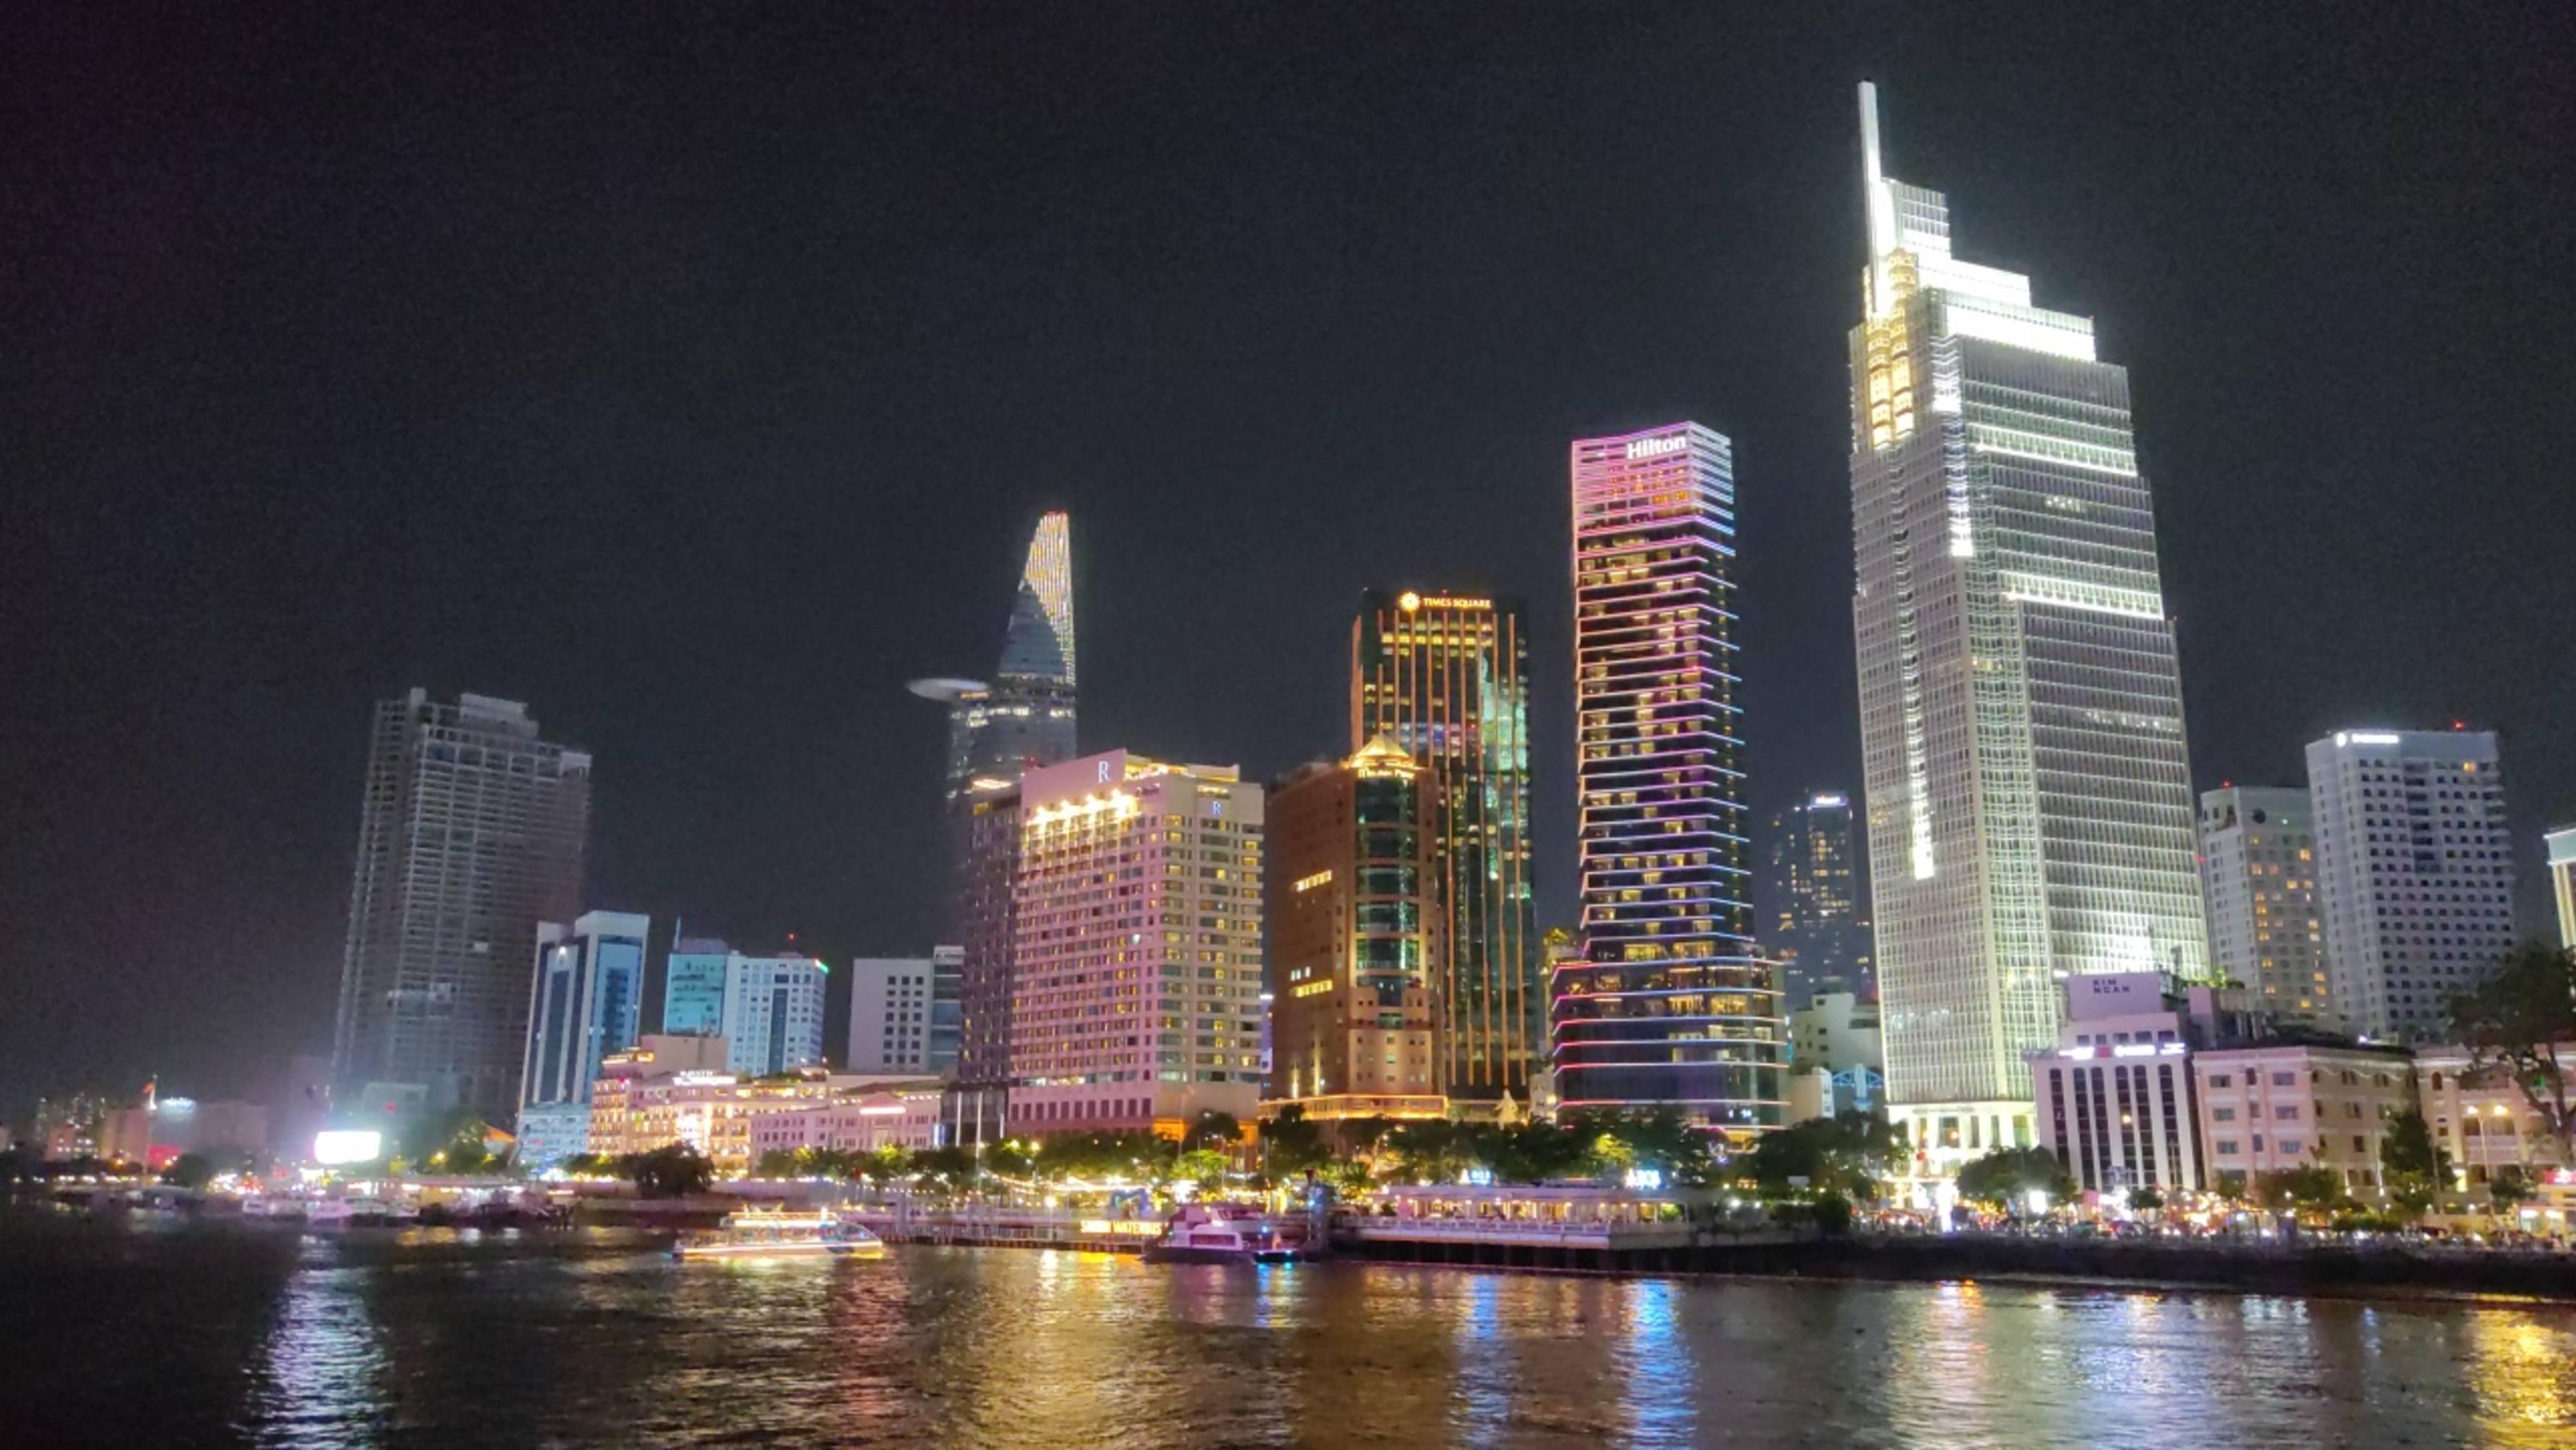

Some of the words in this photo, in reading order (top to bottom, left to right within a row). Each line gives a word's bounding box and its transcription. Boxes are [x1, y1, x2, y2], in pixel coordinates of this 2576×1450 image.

[1627, 436, 1686, 460] Hilton
[1423, 598, 1452, 607] TIMES
[1453, 598, 1492, 609] SQUARE
[1098, 760, 1111, 784] R
[1212, 801, 1222, 815] R
